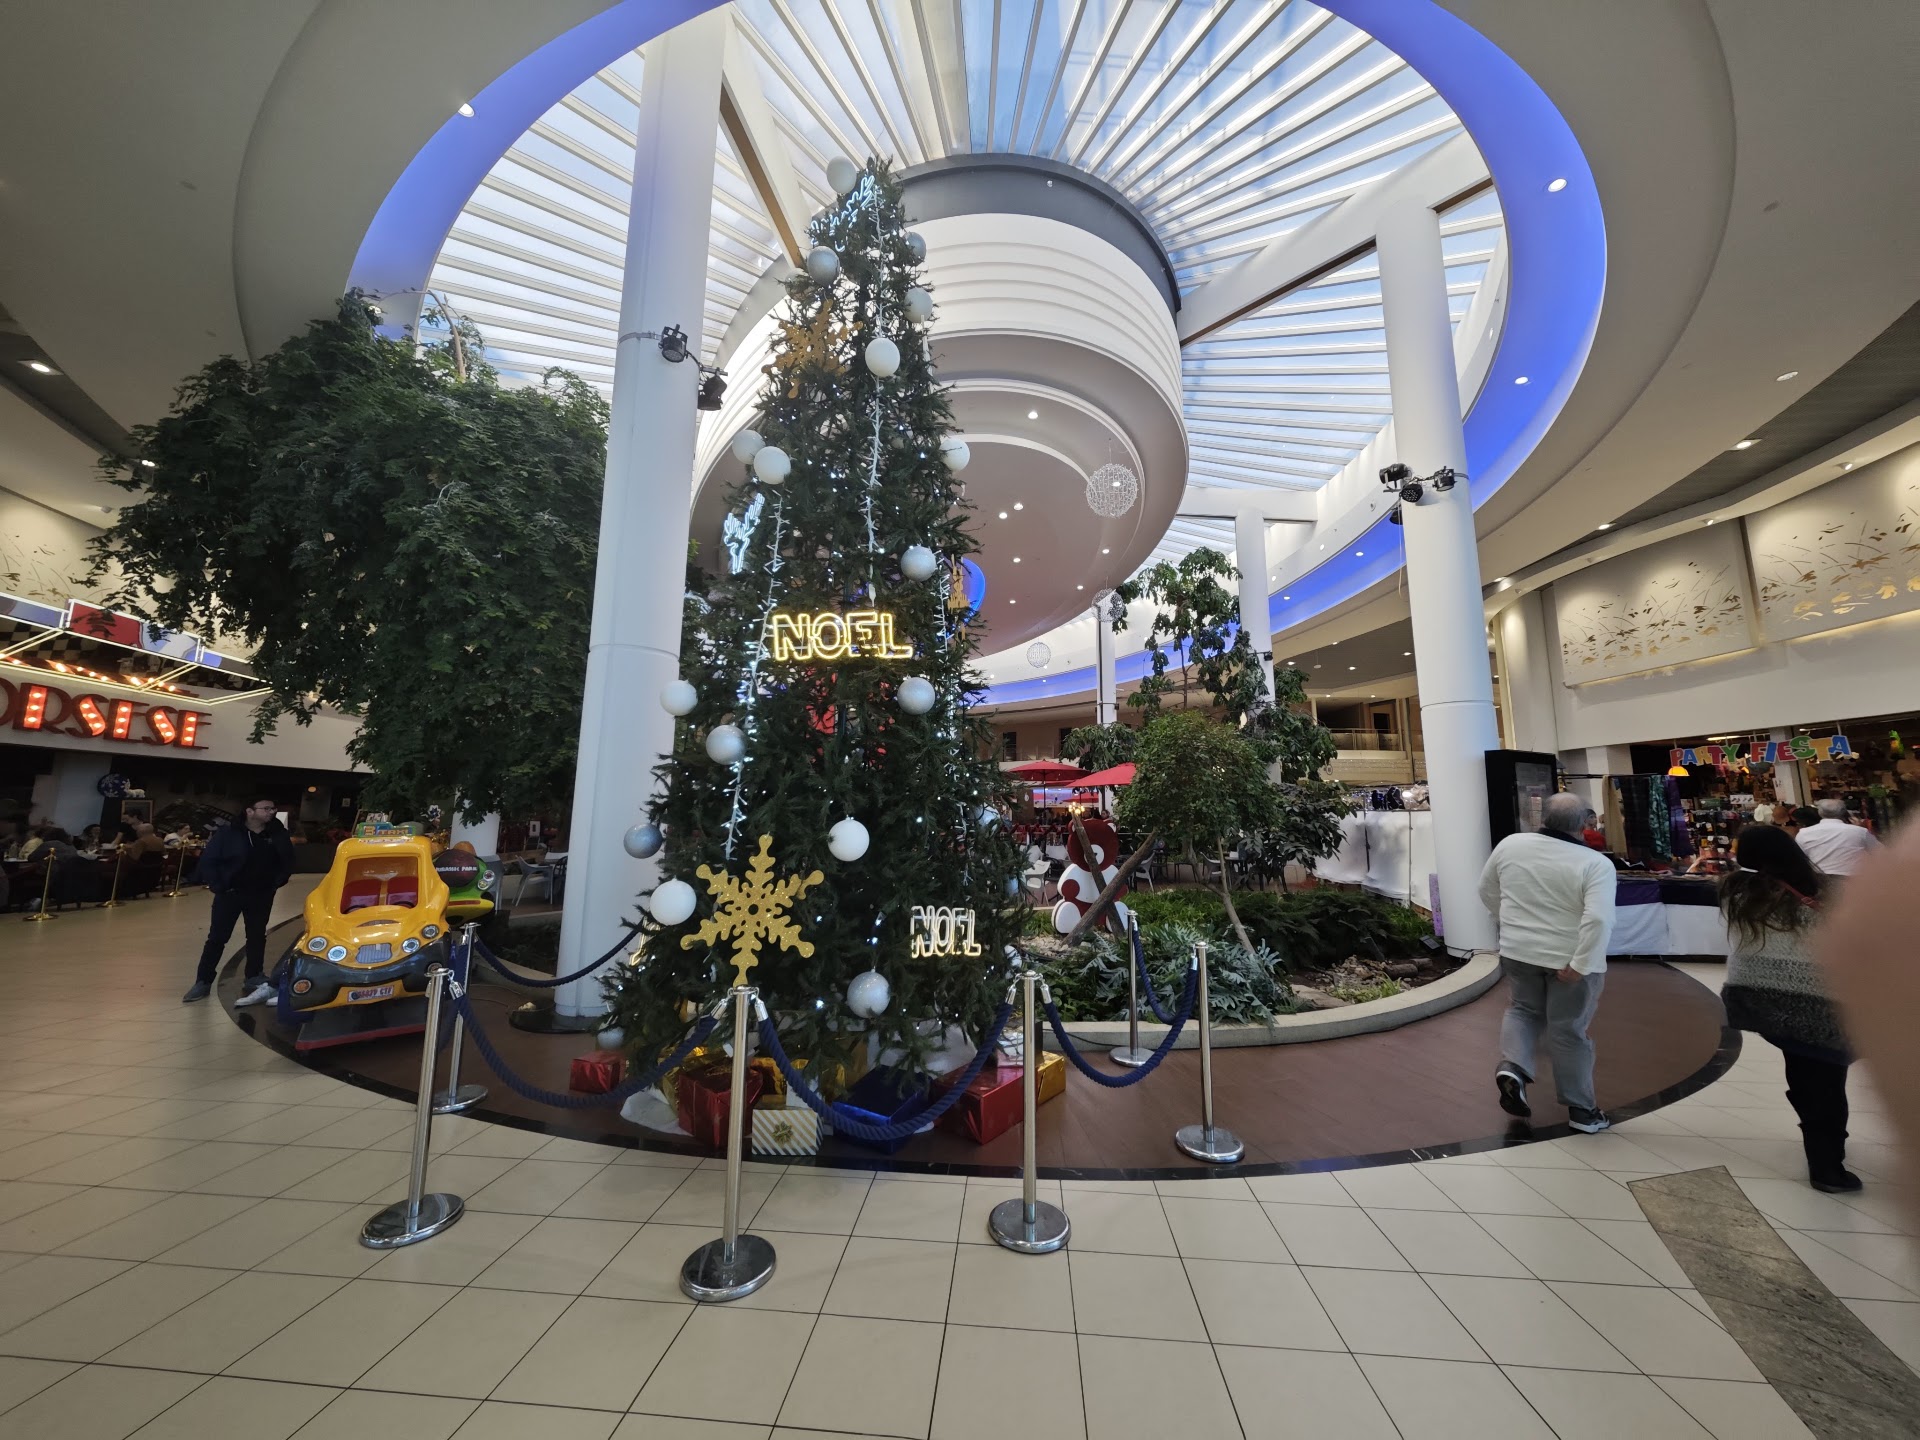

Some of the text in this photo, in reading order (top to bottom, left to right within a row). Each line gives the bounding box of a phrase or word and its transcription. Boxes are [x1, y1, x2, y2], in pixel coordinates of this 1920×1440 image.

[772, 611, 914, 662] NOEL
[1669, 735, 1852, 767] PARTY FIESTA
[910, 905, 981, 958] NOEL
